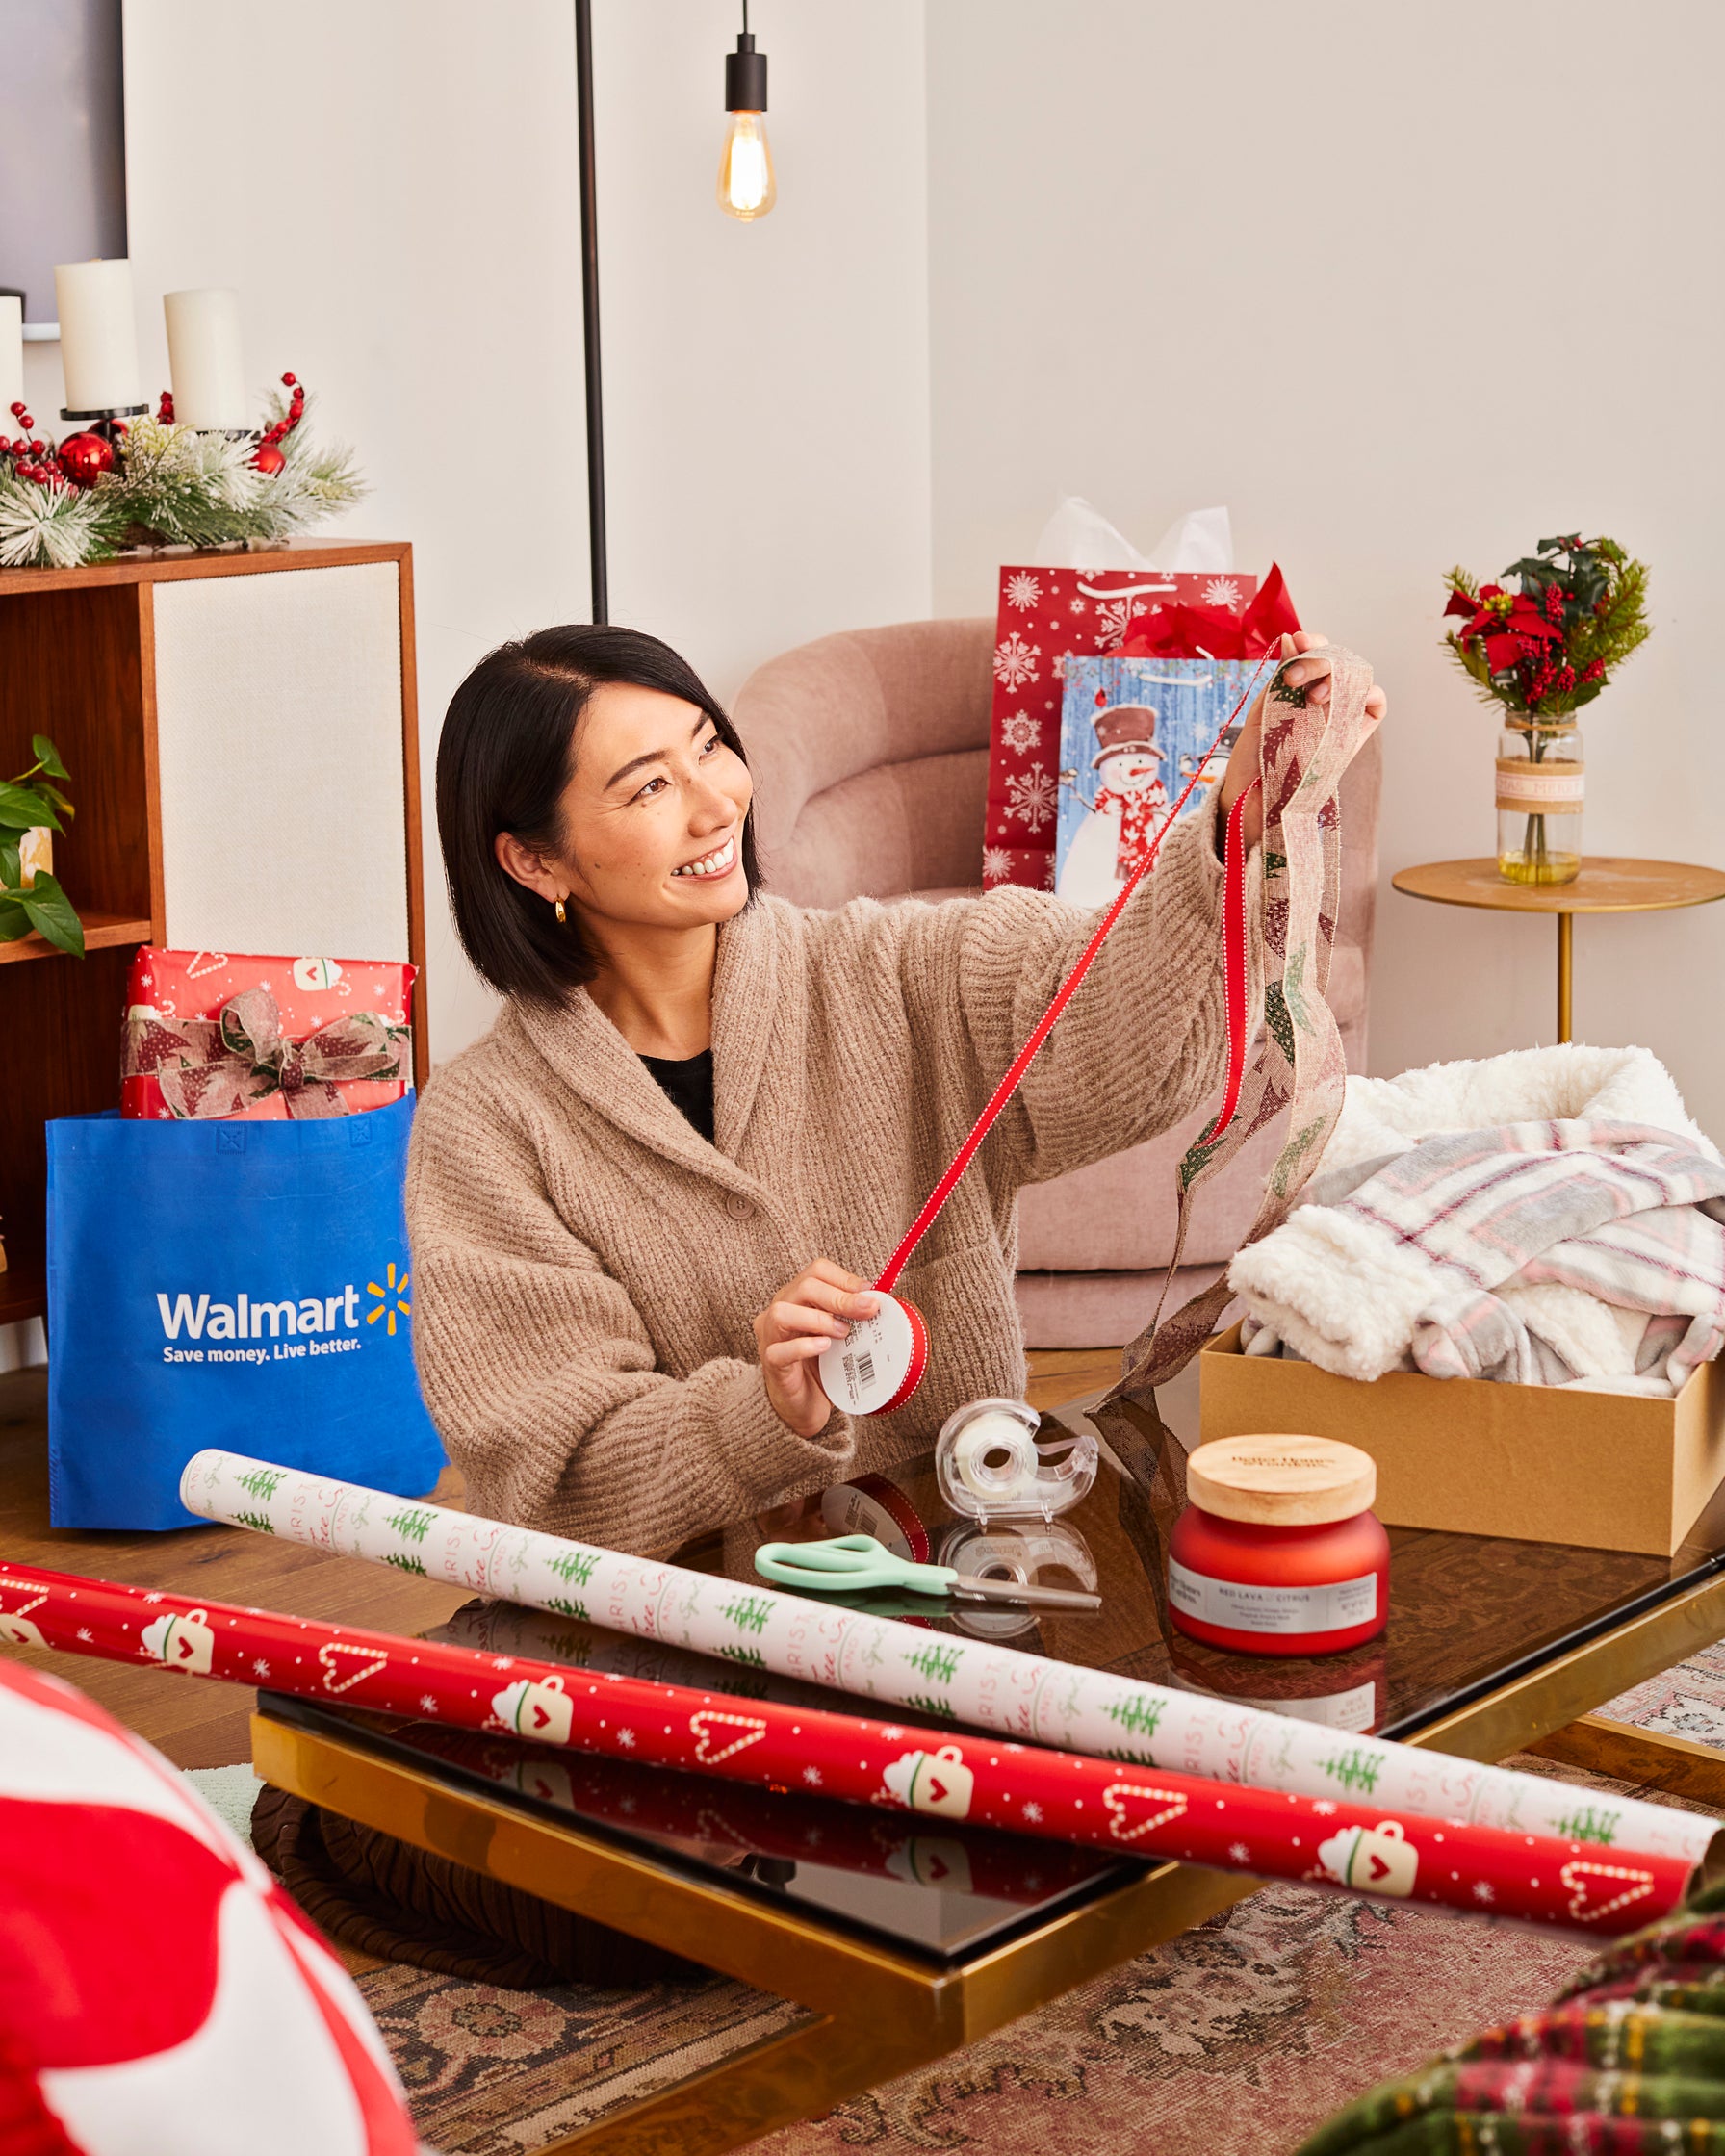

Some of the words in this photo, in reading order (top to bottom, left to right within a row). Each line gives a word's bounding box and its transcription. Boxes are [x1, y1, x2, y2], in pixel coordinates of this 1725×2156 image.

[156, 1284, 360, 1340] Walmart
[163, 1346, 204, 1363] Save
[207, 1348, 270, 1366] money.
[273, 1343, 306, 1360] Live
[309, 1338, 362, 1356] better.
[1238, 1591, 1263, 1602] LAVA
[1276, 1593, 1310, 1602] CITRUS
